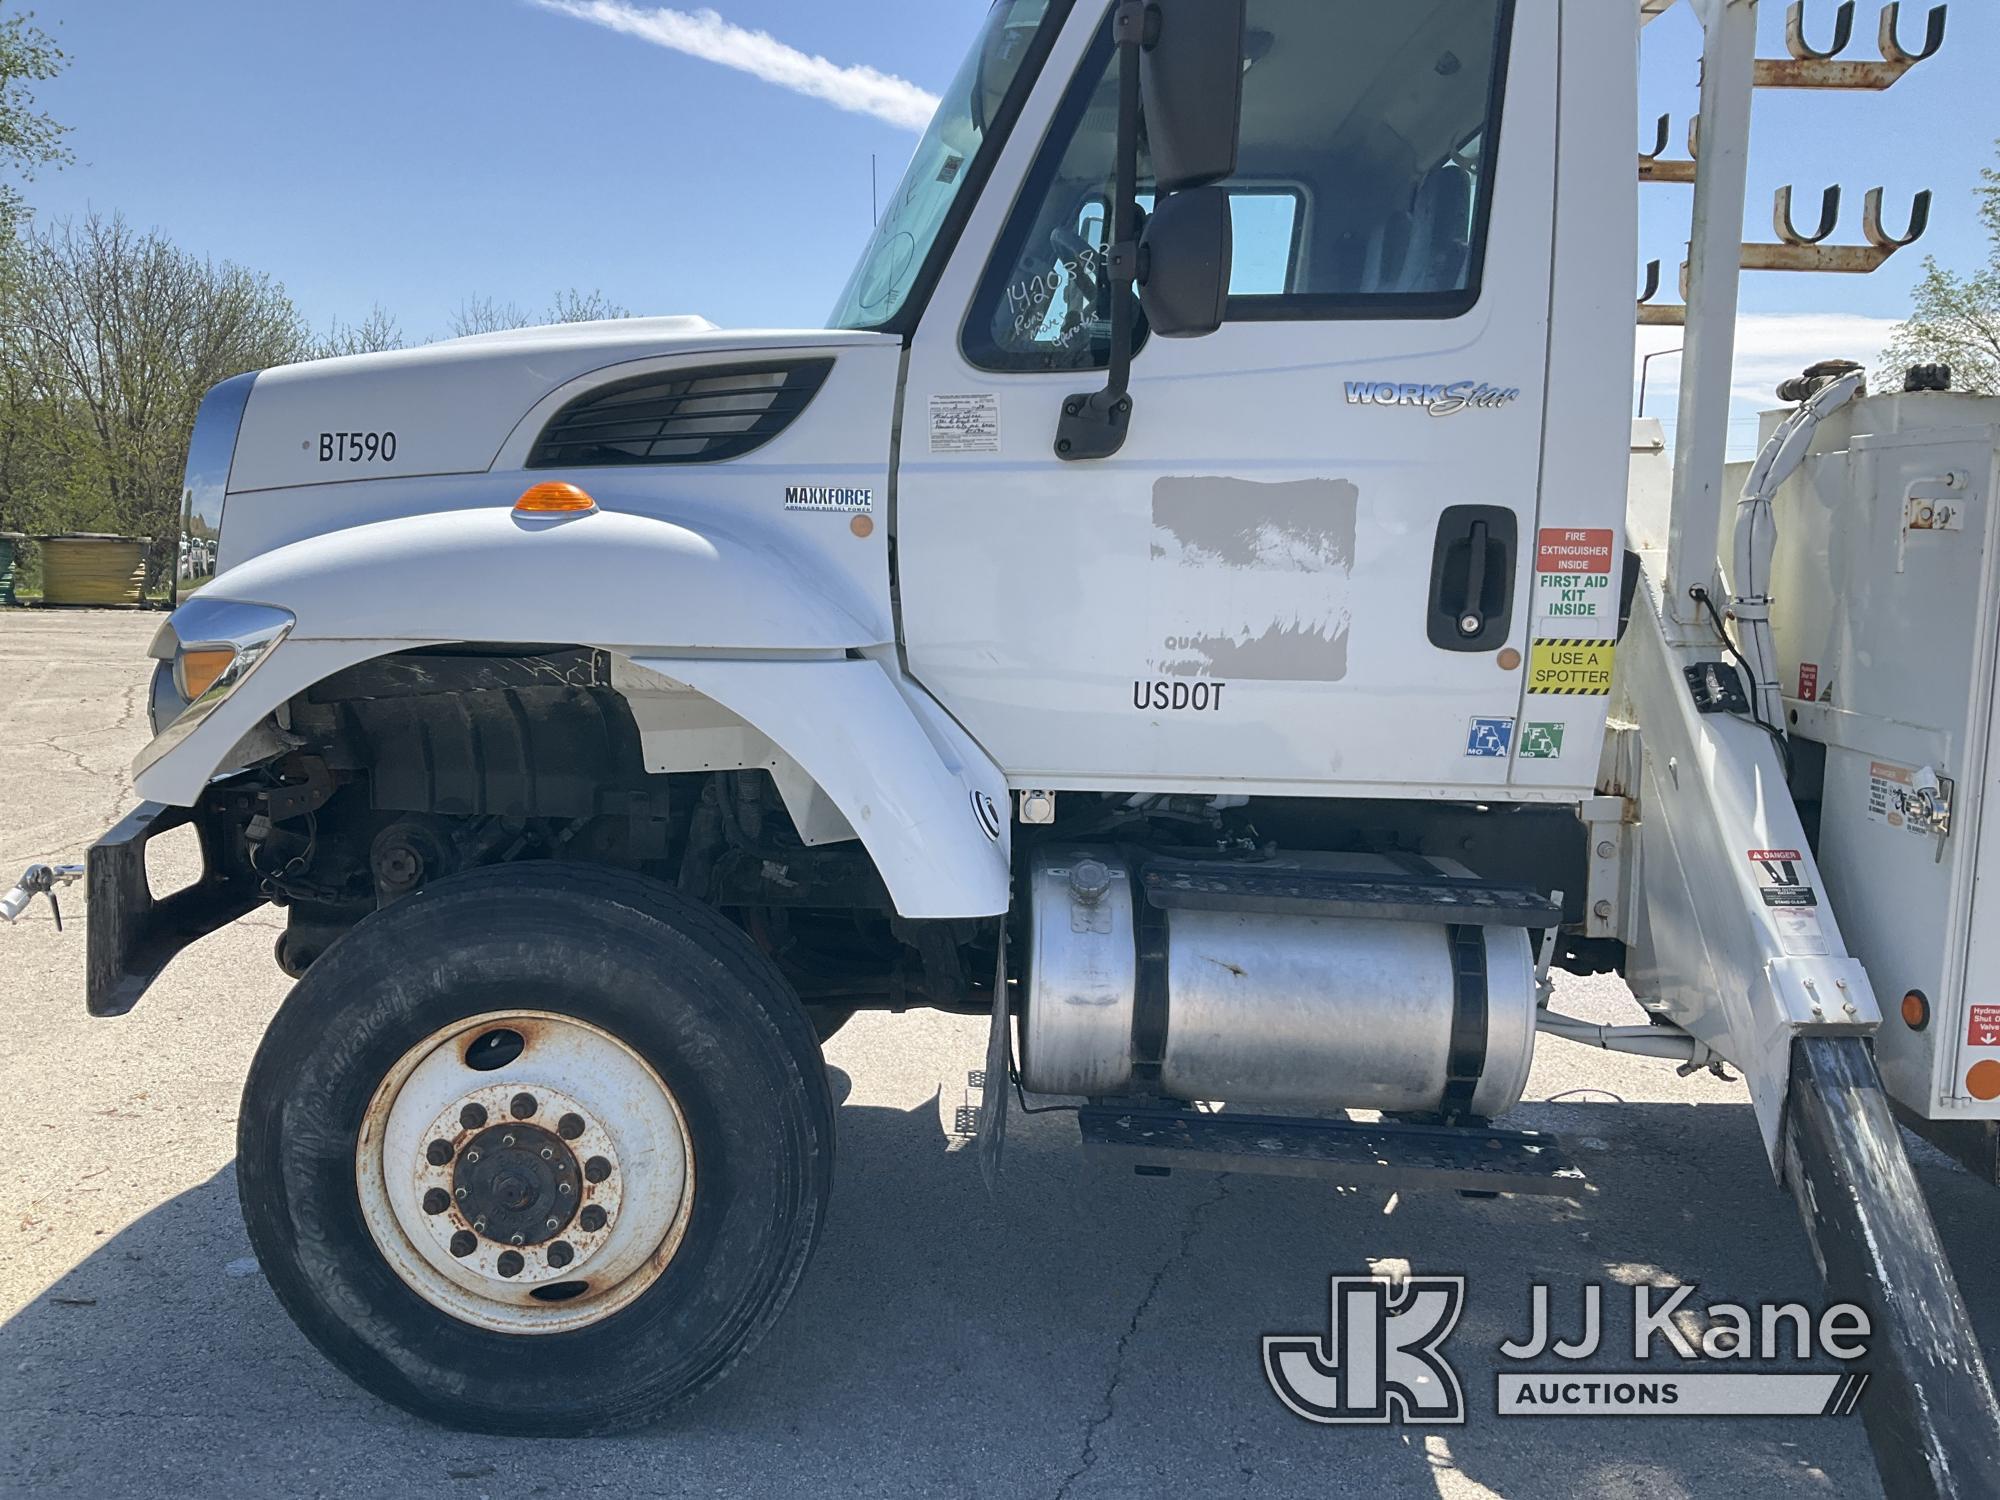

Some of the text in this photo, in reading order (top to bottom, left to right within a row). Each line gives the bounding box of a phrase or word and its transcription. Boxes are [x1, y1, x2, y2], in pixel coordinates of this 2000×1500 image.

[1344, 381, 1520, 417] WORKStar
[319, 431, 397, 462] BT590
[785, 487, 871, 506] MAXXFORCE
[1565, 532, 1587, 541] FIRE
[1541, 545, 1609, 556] EXTINGUISHER
[1558, 560, 1589, 570] INSIDE
[1540, 575, 1609, 588] FIRST AID
[1561, 589, 1586, 602] KIT
[1548, 603, 1596, 616] INSIDE
[1550, 652, 1598, 665] USE A
[1535, 669, 1609, 683] SPOTTER
[1133, 680, 1226, 711] USDOT
